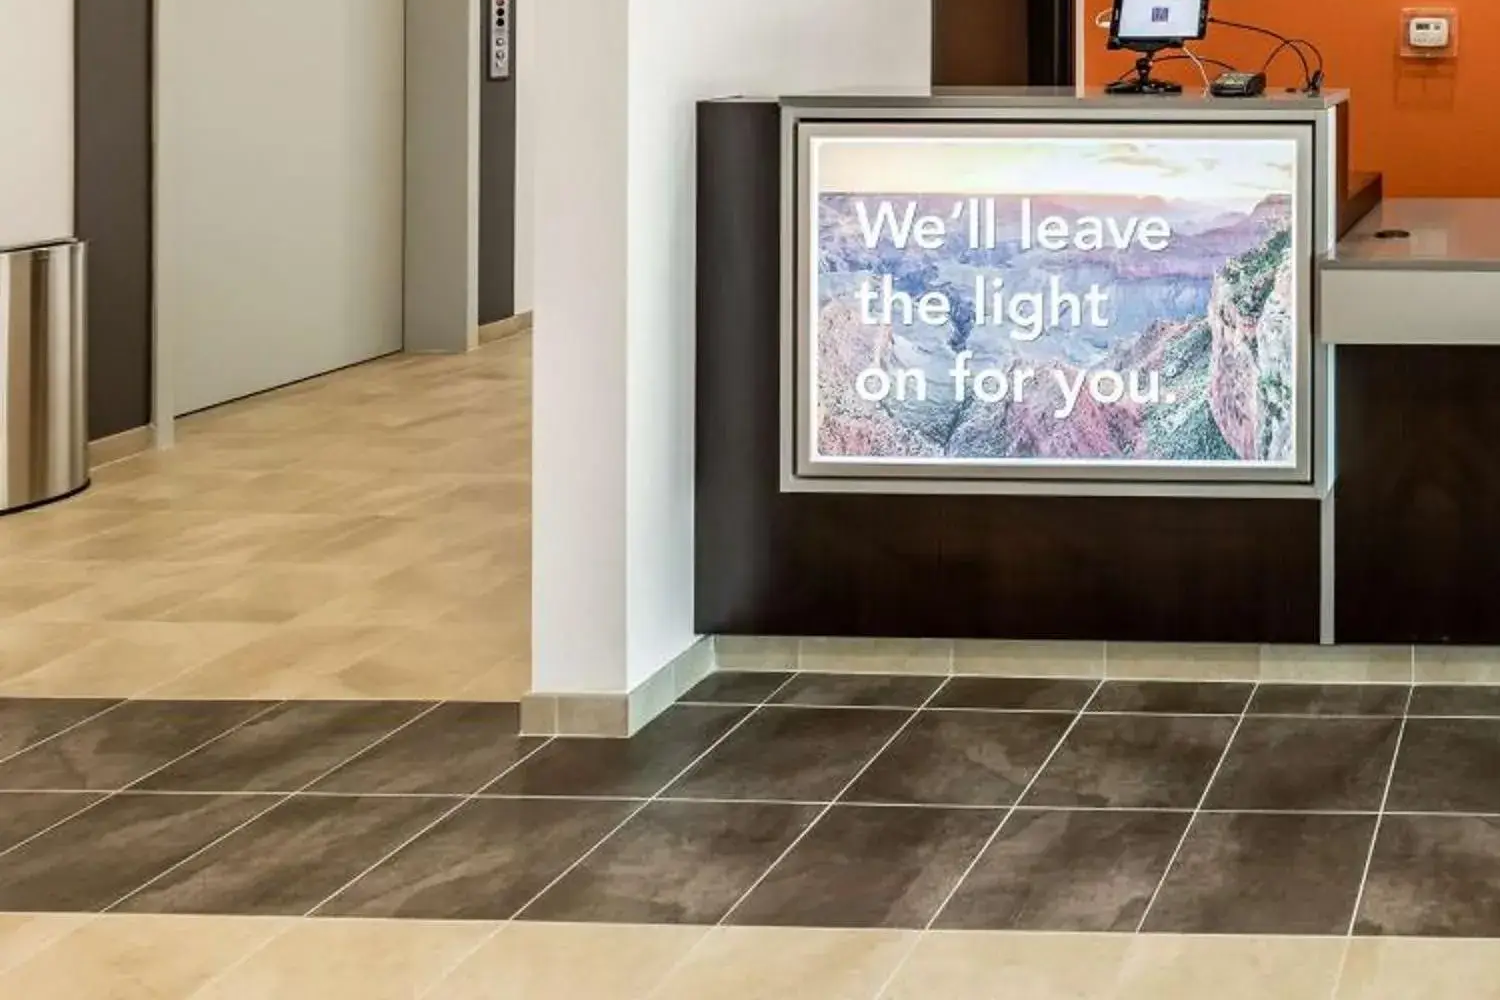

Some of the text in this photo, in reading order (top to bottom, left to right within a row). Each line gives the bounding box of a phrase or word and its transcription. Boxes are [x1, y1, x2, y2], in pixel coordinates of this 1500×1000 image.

[855, 198, 1171, 251] We'll leave
[854, 274, 1109, 341] the light
[856, 351, 1177, 417] on for you.
